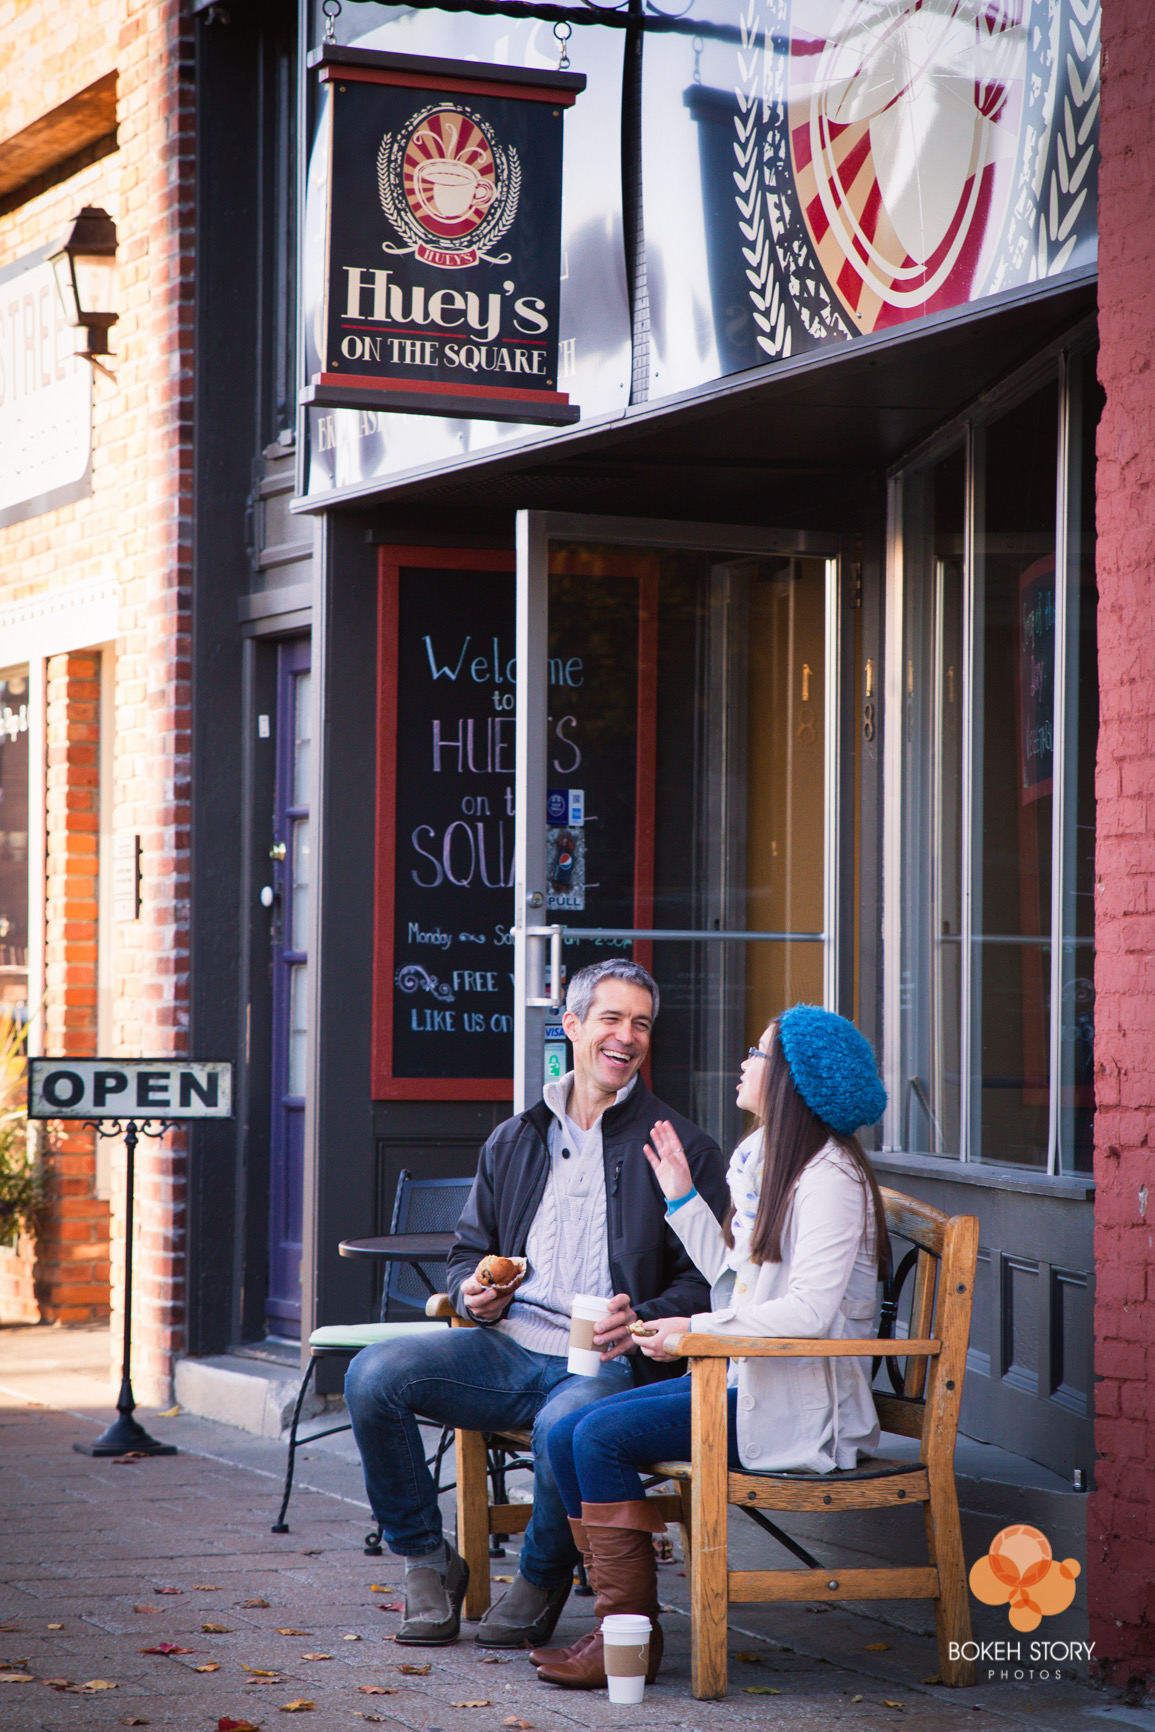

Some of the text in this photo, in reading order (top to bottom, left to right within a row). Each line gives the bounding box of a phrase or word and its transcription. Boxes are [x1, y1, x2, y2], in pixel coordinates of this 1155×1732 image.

[423, 248, 475, 266] HUEY'S
[341, 266, 549, 343] Huey's
[341, 335, 382, 361] ON
[387, 338, 439, 366] THE
[444, 344, 547, 375] SQUARE
[422, 634, 585, 687] Welcme
[492, 691, 515, 711] to
[461, 796, 490, 816] on
[548, 896, 581, 906] PULL
[408, 921, 452, 950] Monday
[453, 970, 498, 992] FREE
[411, 1008, 456, 1031] LIKE
[463, 1012, 486, 1032] US
[545, 1027, 566, 1037] VISA
[42, 1070, 219, 1108] OPEN
